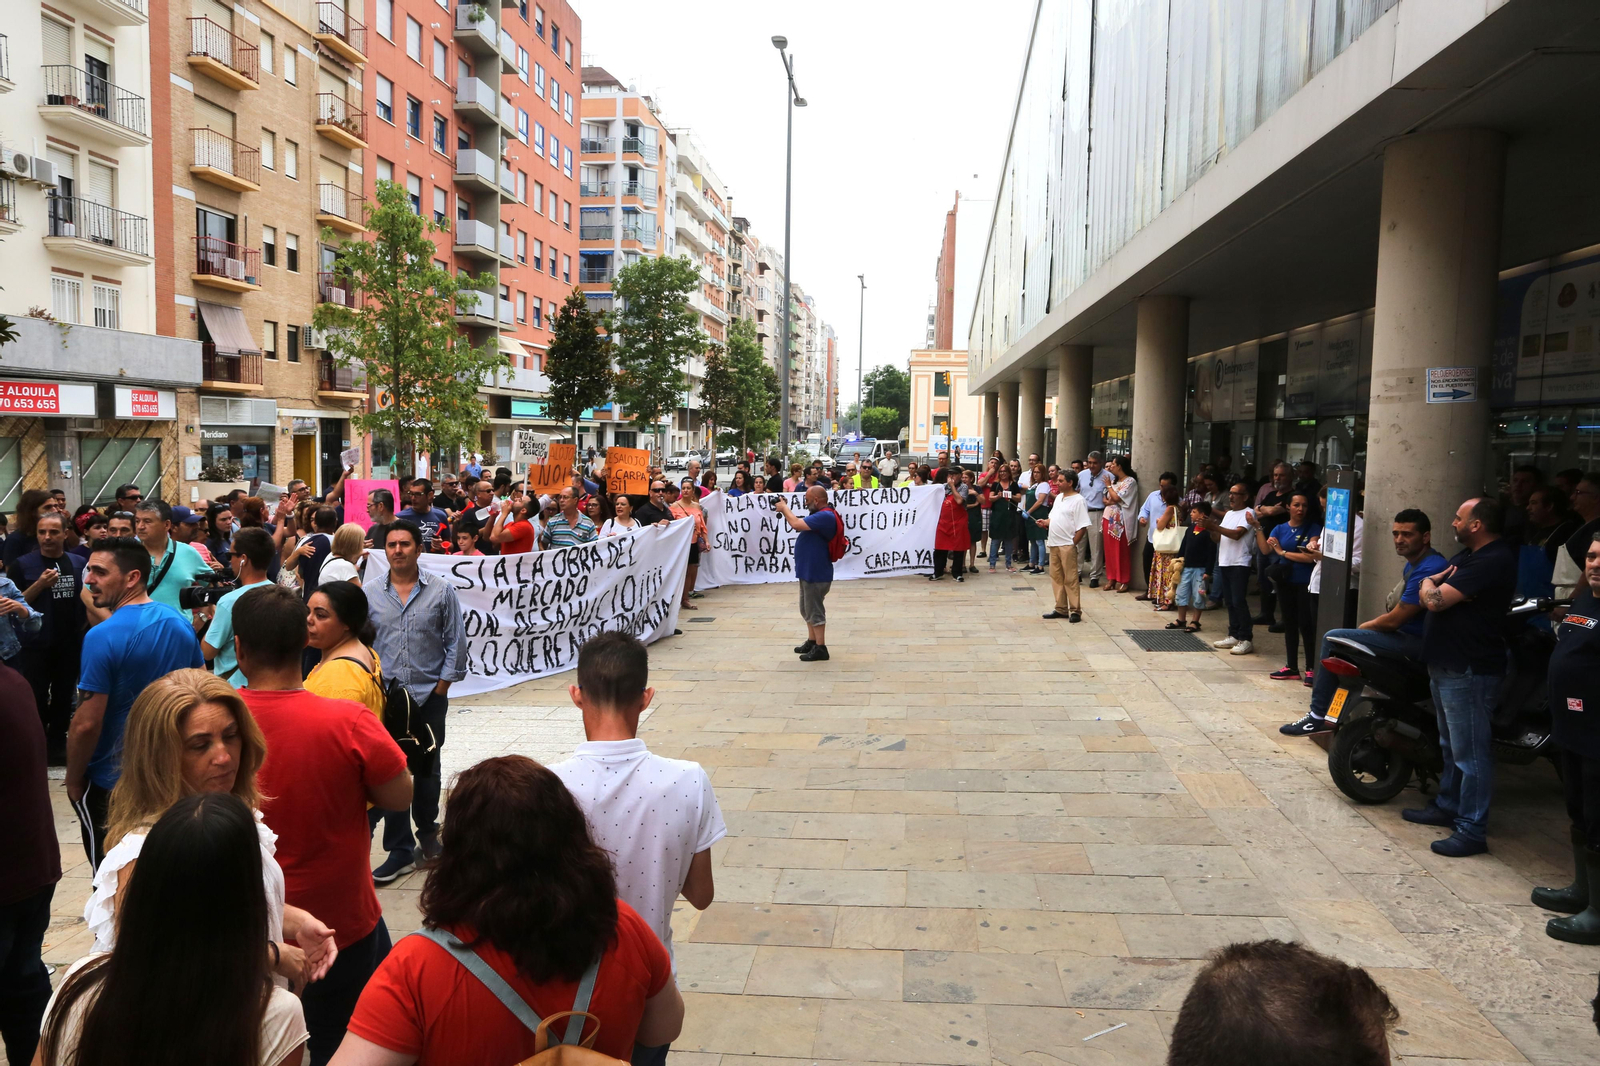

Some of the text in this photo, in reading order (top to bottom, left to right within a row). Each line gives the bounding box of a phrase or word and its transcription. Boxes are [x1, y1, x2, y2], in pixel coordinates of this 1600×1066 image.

[7, 386, 56, 398] ALQUILA
[132, 394, 158, 402] SE ALQUILA
[14, 398, 34, 408] 653
[36, 400, 56, 410] 655
[538, 464, 566, 486] NO!
[615, 469, 647, 482] CARPA
[726, 498, 734, 514] A
[737, 494, 754, 512] LA
[833, 487, 911, 508] MERCADO
[728, 518, 751, 534] NO
[713, 532, 748, 553] SOLO
[494, 556, 510, 588] A
[516, 553, 545, 585] LA
[552, 542, 604, 579] OBRA
[606, 536, 637, 570] DEL
[865, 551, 911, 570] CARPA
[490, 576, 588, 611] MERCADO
[481, 613, 502, 638] AL
